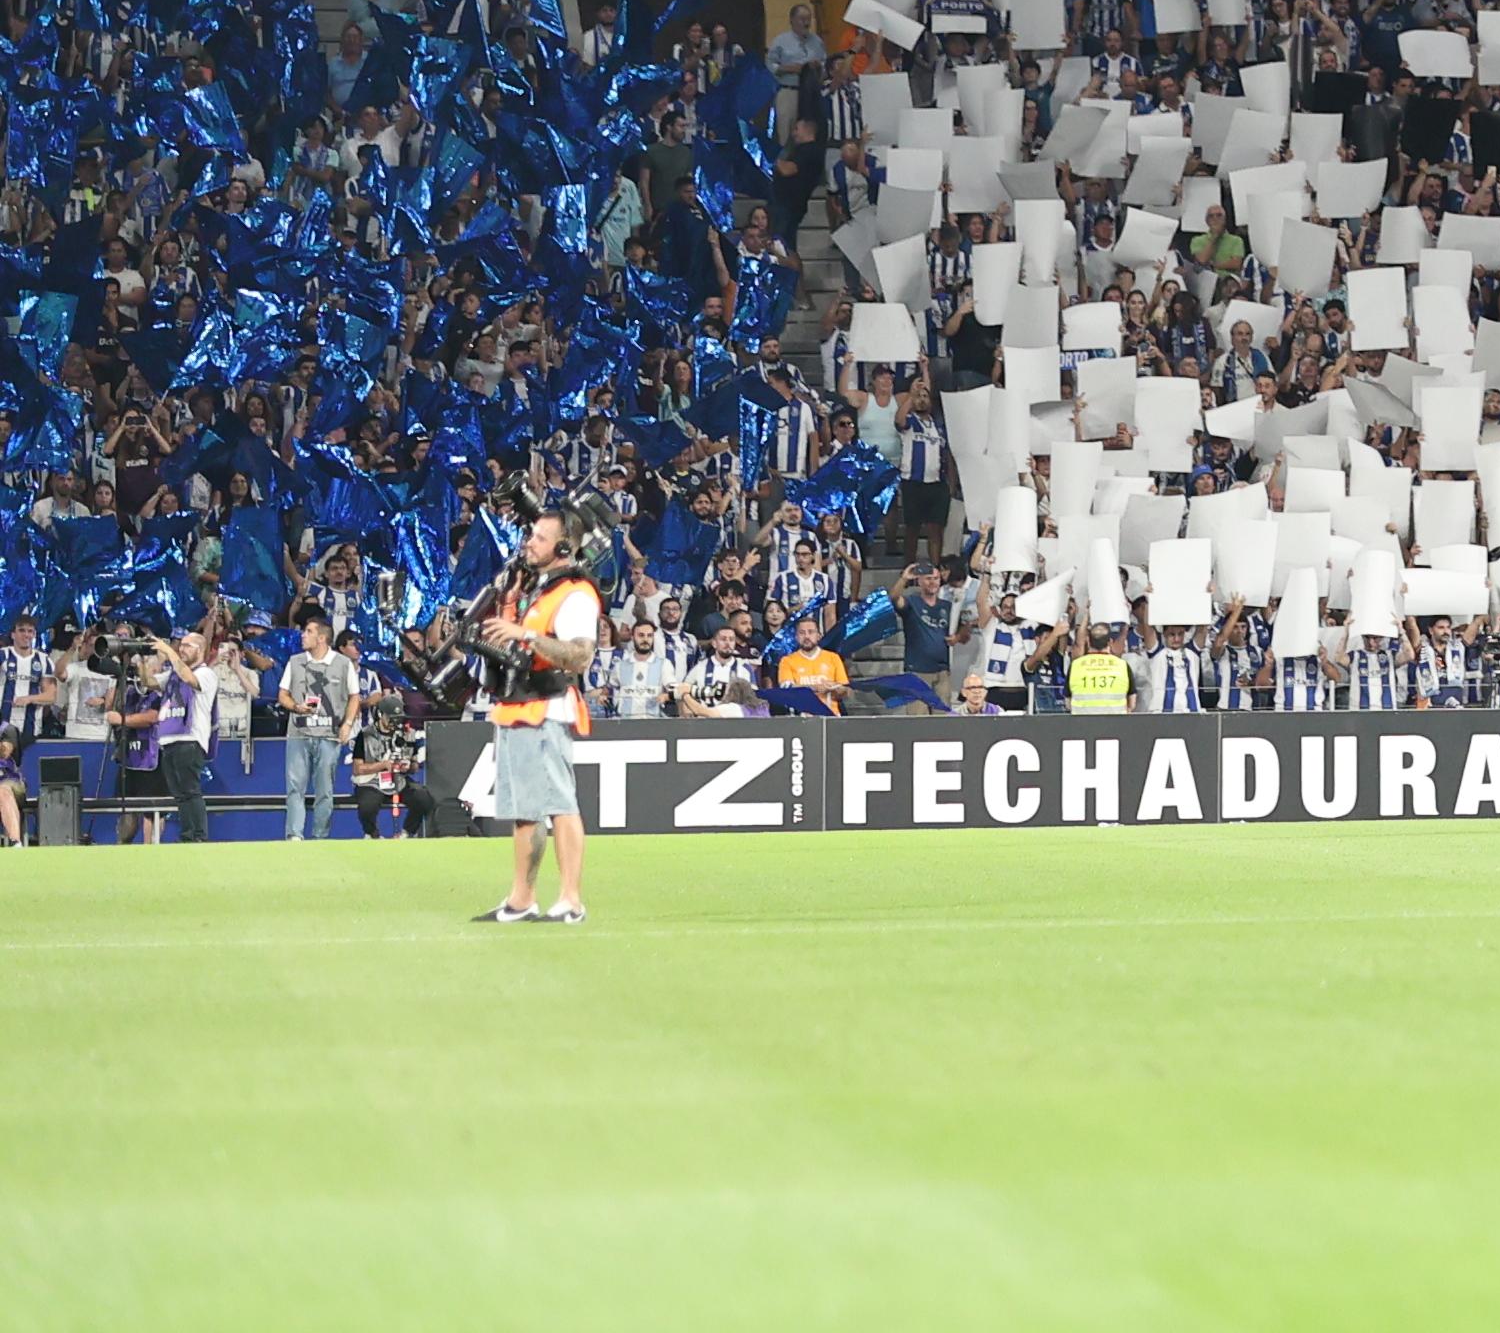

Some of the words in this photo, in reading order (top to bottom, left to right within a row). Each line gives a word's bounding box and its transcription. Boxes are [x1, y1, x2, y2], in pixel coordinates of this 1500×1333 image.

[940, 1, 984, 11] PORTO
[1081, 675, 1117, 689] 1137
[791, 737, 805, 797] GROUP
